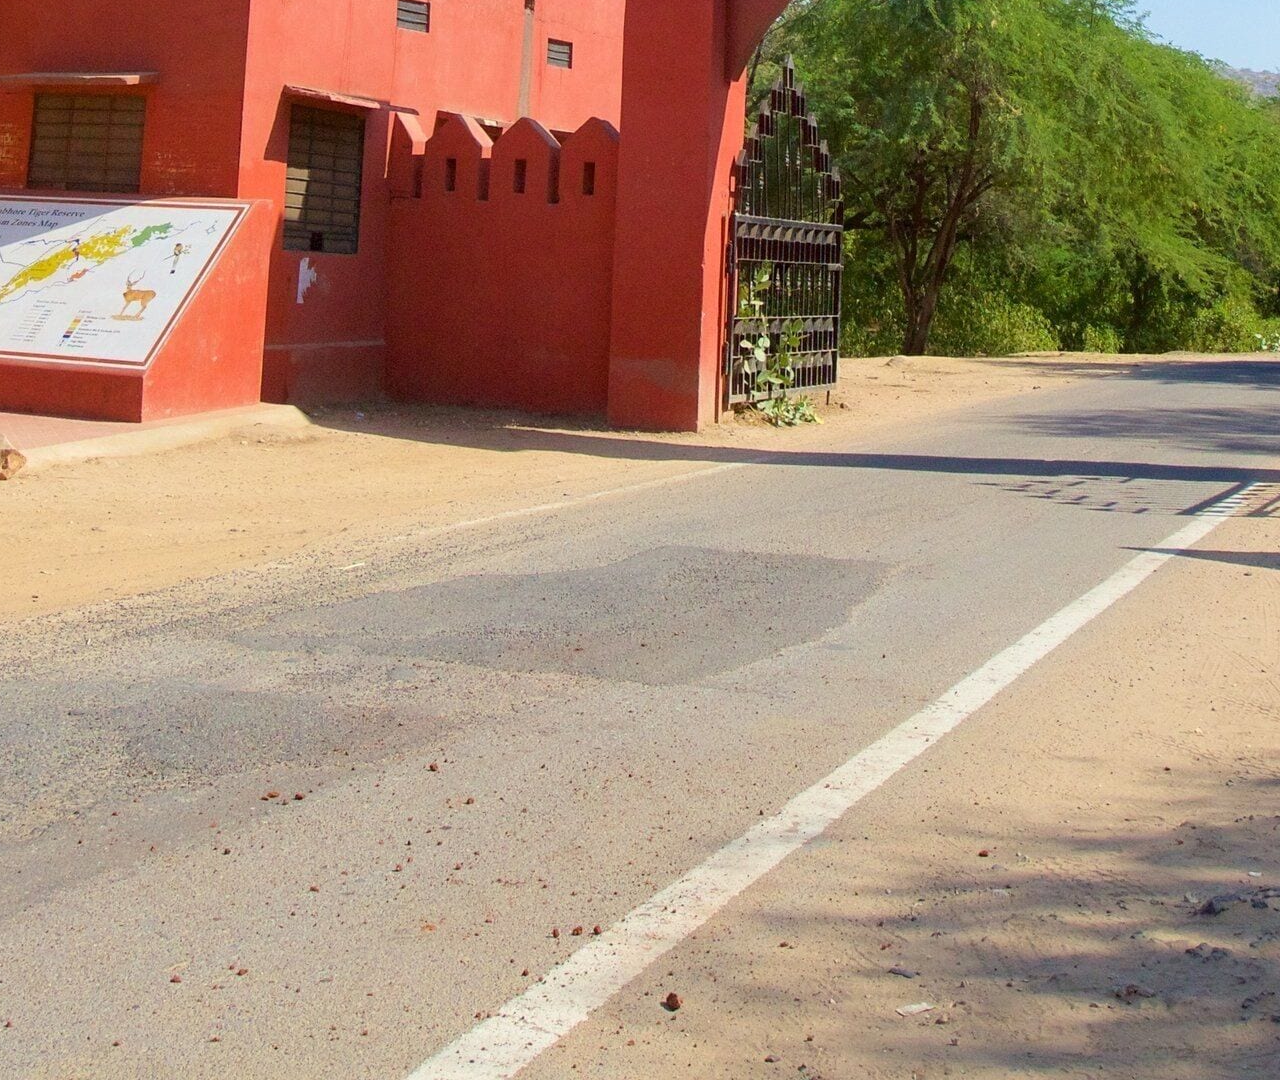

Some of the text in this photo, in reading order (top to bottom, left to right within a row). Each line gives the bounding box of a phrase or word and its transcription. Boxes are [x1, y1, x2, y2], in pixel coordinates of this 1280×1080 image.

[28, 208, 50, 217] Tiger
[50, 209, 85, 217] Reserve
[38, 220, 58, 229] Map
